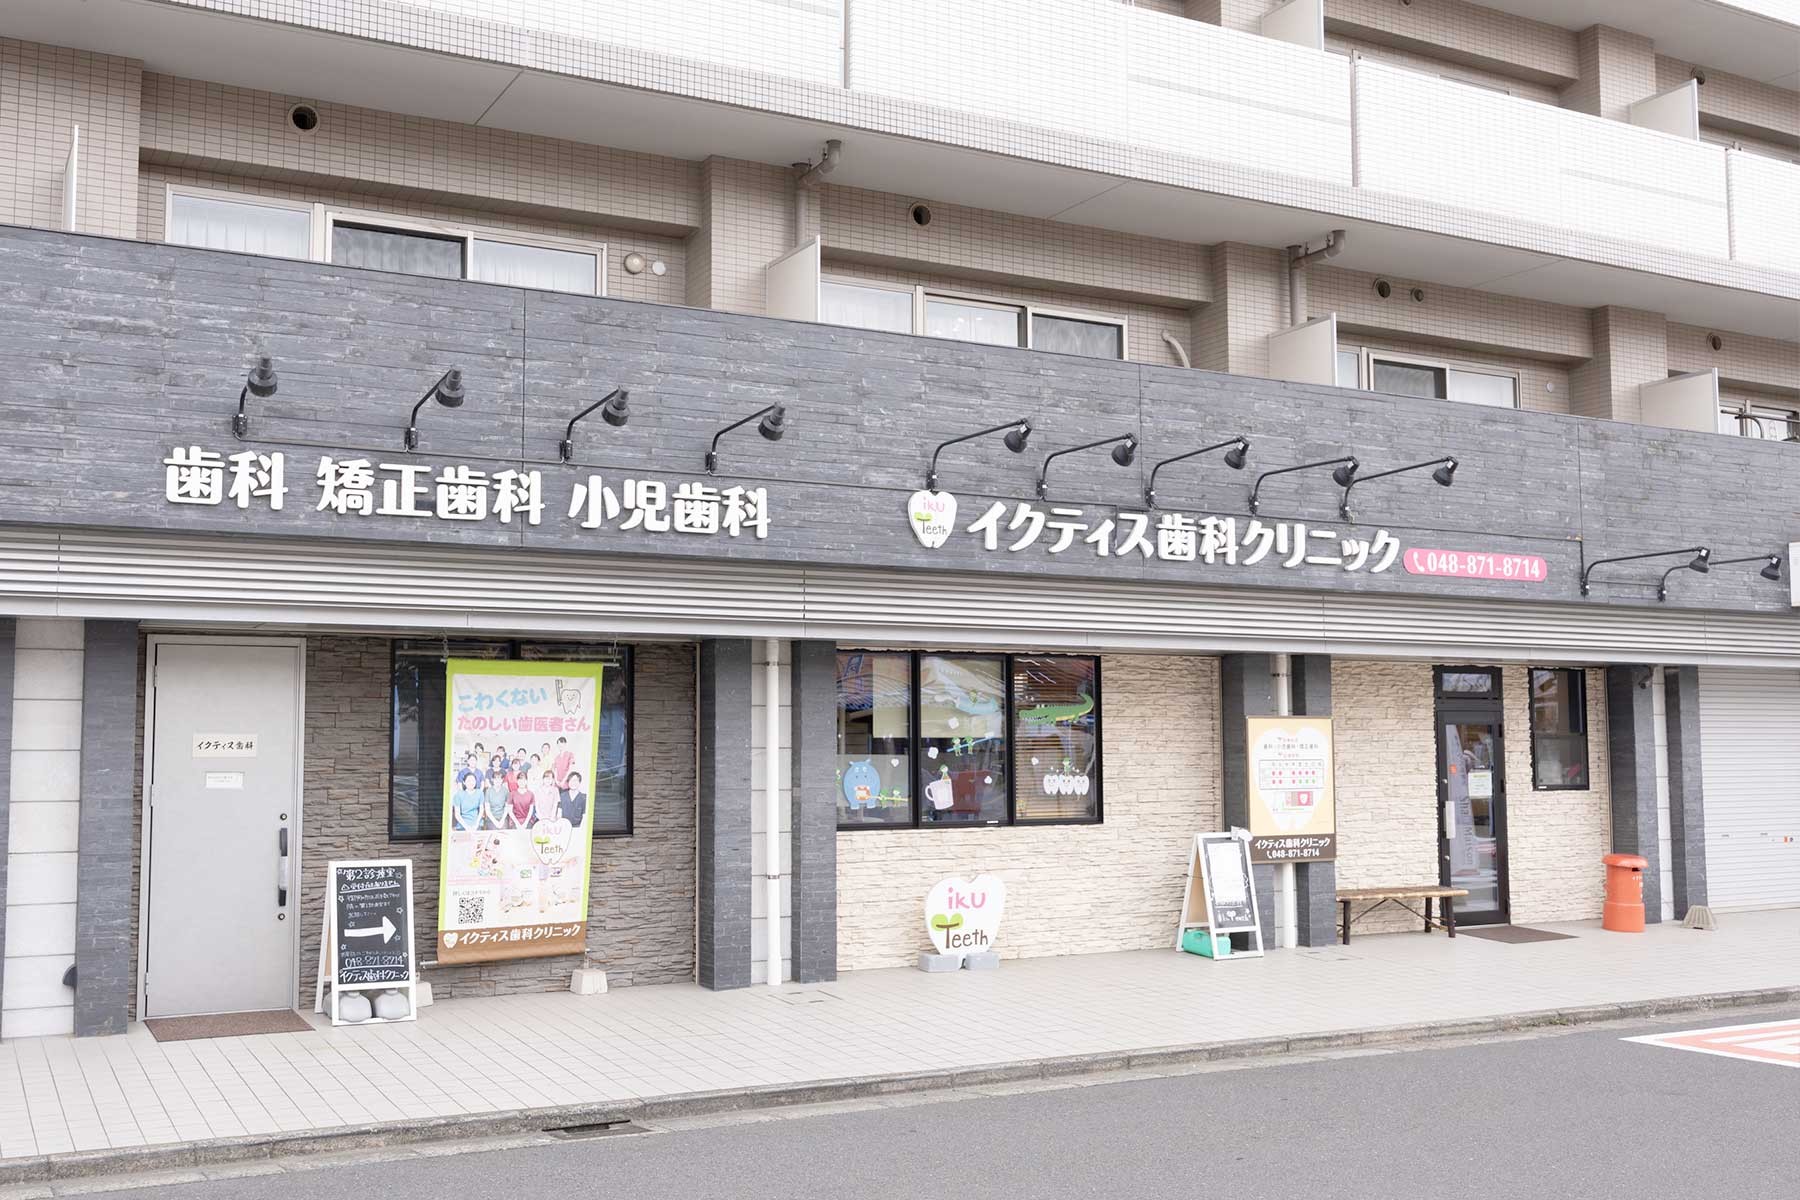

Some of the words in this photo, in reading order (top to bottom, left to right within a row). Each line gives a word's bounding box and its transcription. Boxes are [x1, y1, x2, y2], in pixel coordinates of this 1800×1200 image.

[162, 445, 289, 511] 歯科
[315, 454, 545, 526] 矯正歯科
[568, 475, 772, 539] 小児歯科
[916, 517, 948, 536] Teeth
[965, 500, 1400, 575] イクティス歯科クリニック
[1426, 553, 1541, 580] 048-871-8714
[457, 687, 548, 713] こわくない
[457, 715, 591, 733] たのしい歯医者さん
[196, 740, 254, 751] イクティス歯科
[535, 840, 564, 855] Teeth
[1254, 836, 1331, 849] イクティス歯科クリニック
[1271, 849, 1320, 859] 048-871-8714
[459, 923, 582, 945] イクティス歯科クリニック
[935, 922, 989, 949] Teeth
